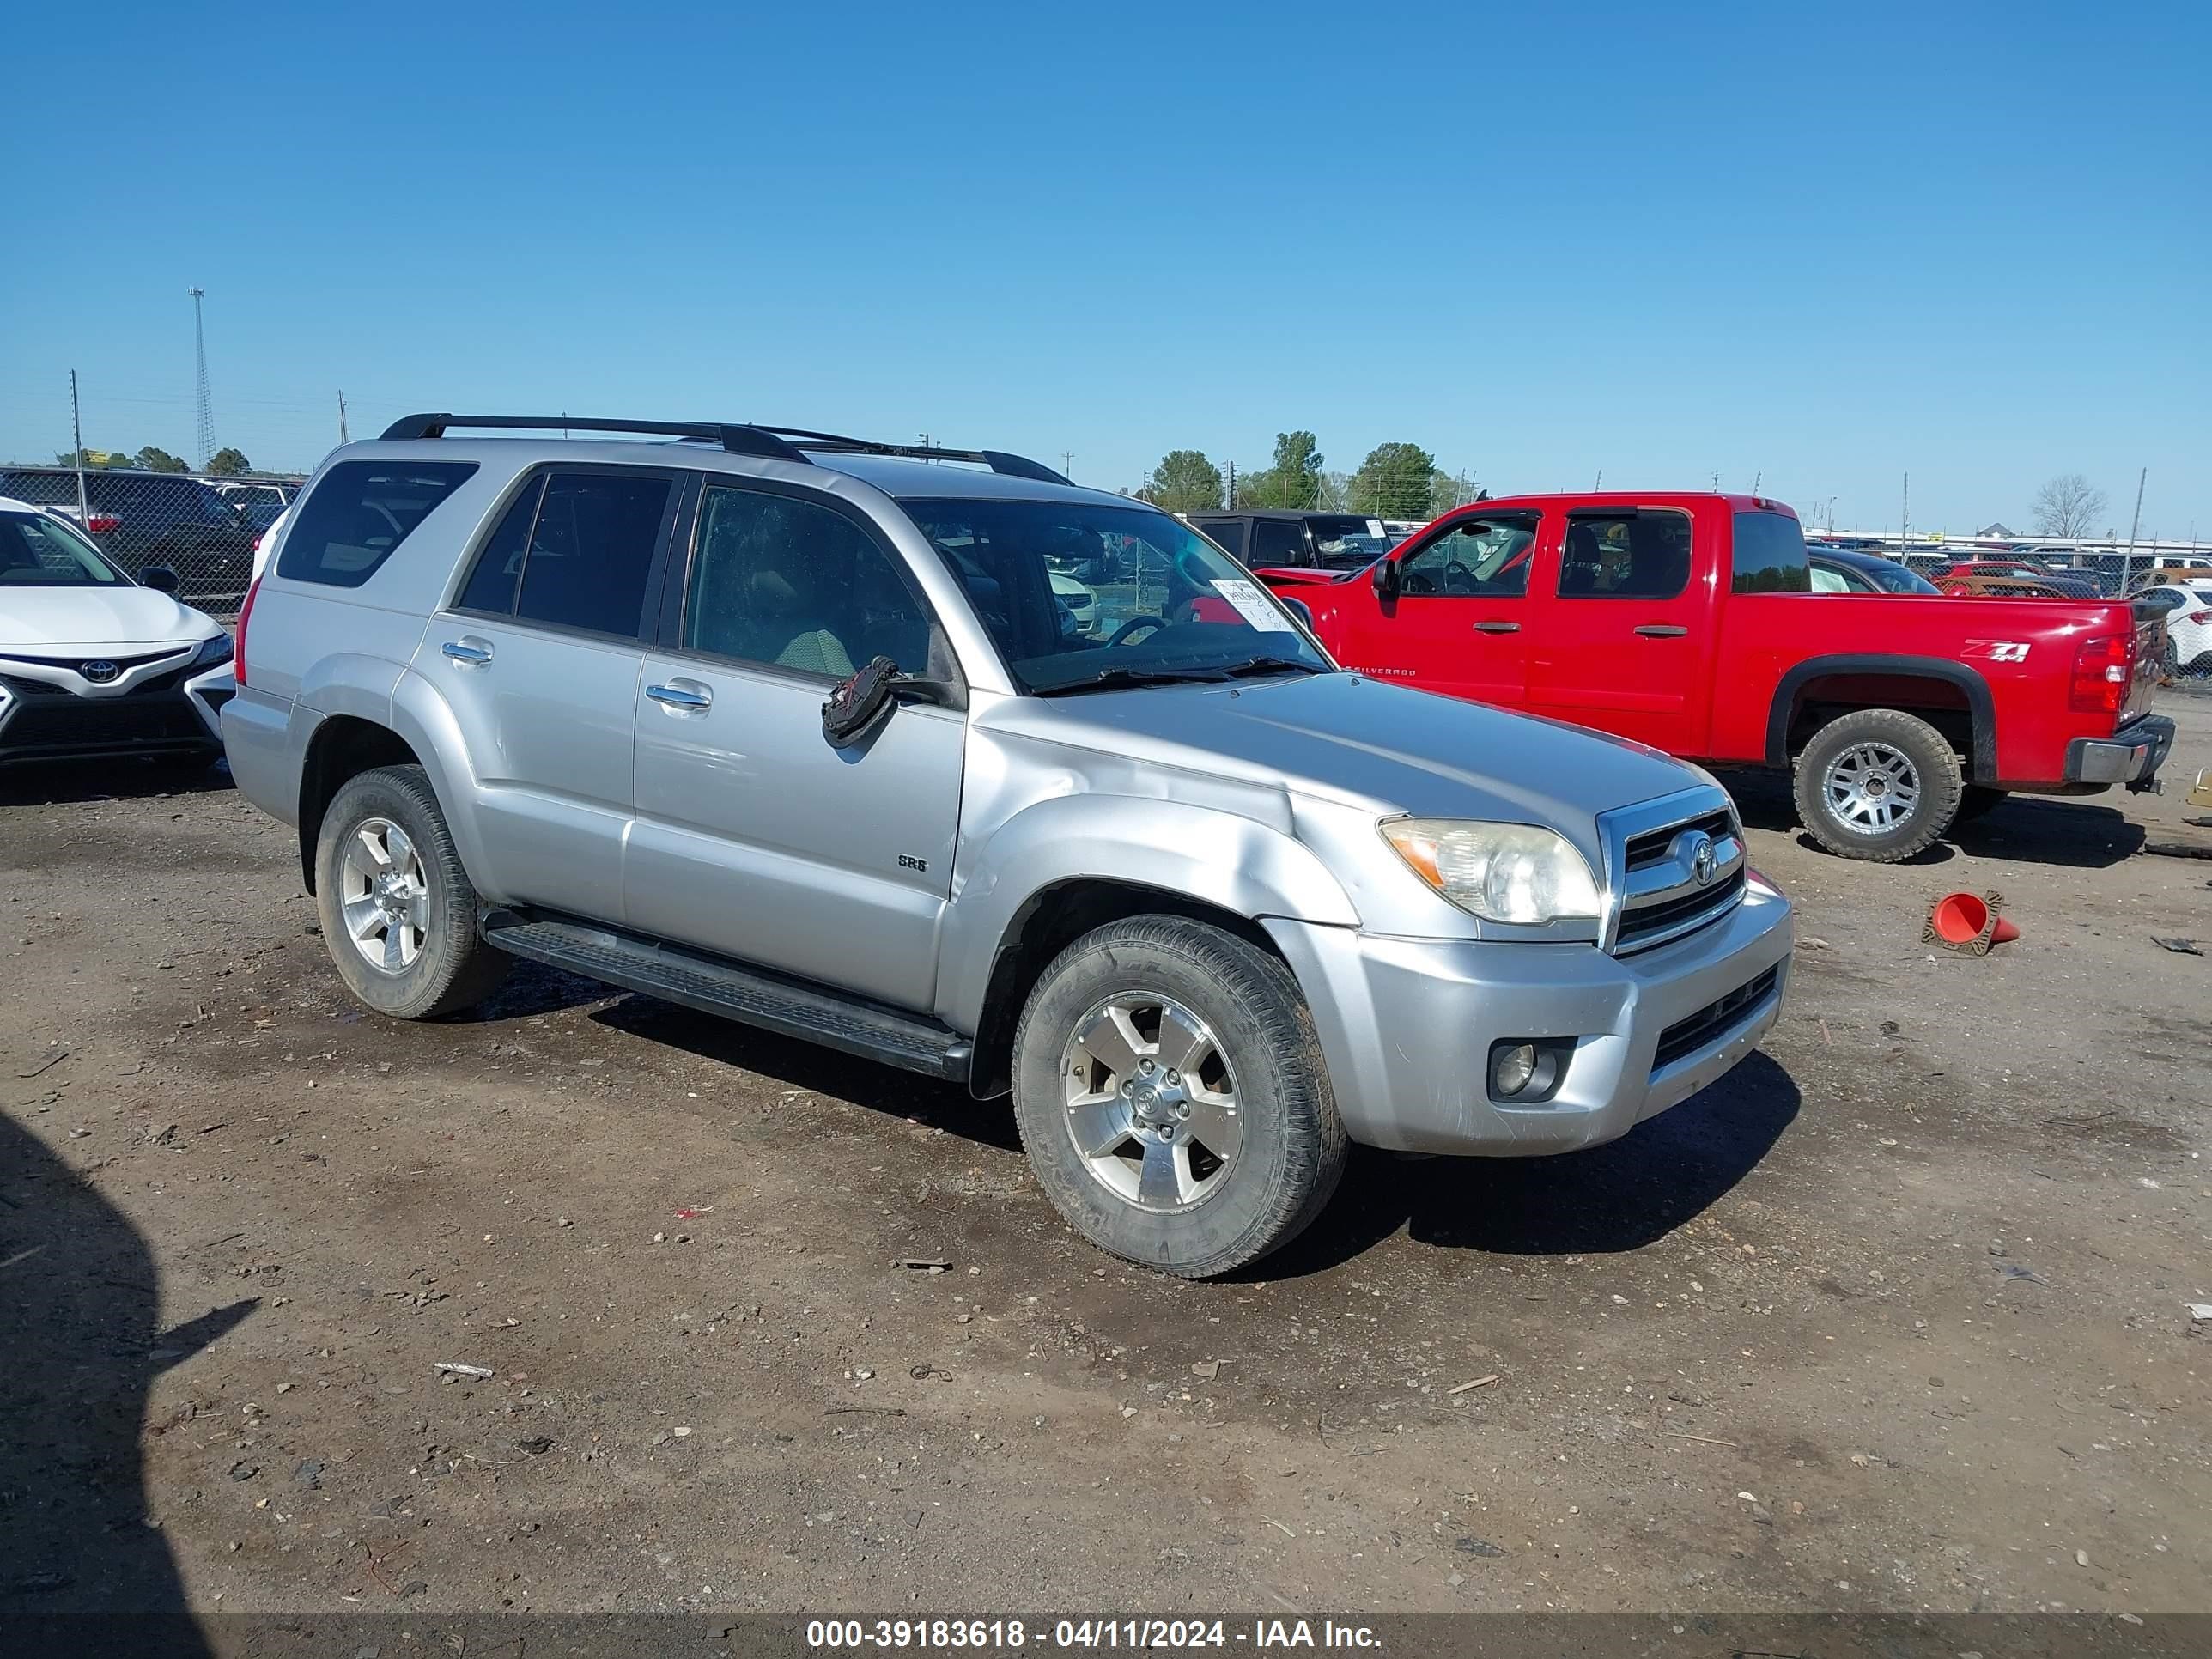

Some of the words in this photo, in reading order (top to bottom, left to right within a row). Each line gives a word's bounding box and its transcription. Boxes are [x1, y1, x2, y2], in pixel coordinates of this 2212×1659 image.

[1960, 639, 2031, 658] Z71
[1354, 666, 1416, 677] SILVERADO
[898, 854, 927, 872] SR5
